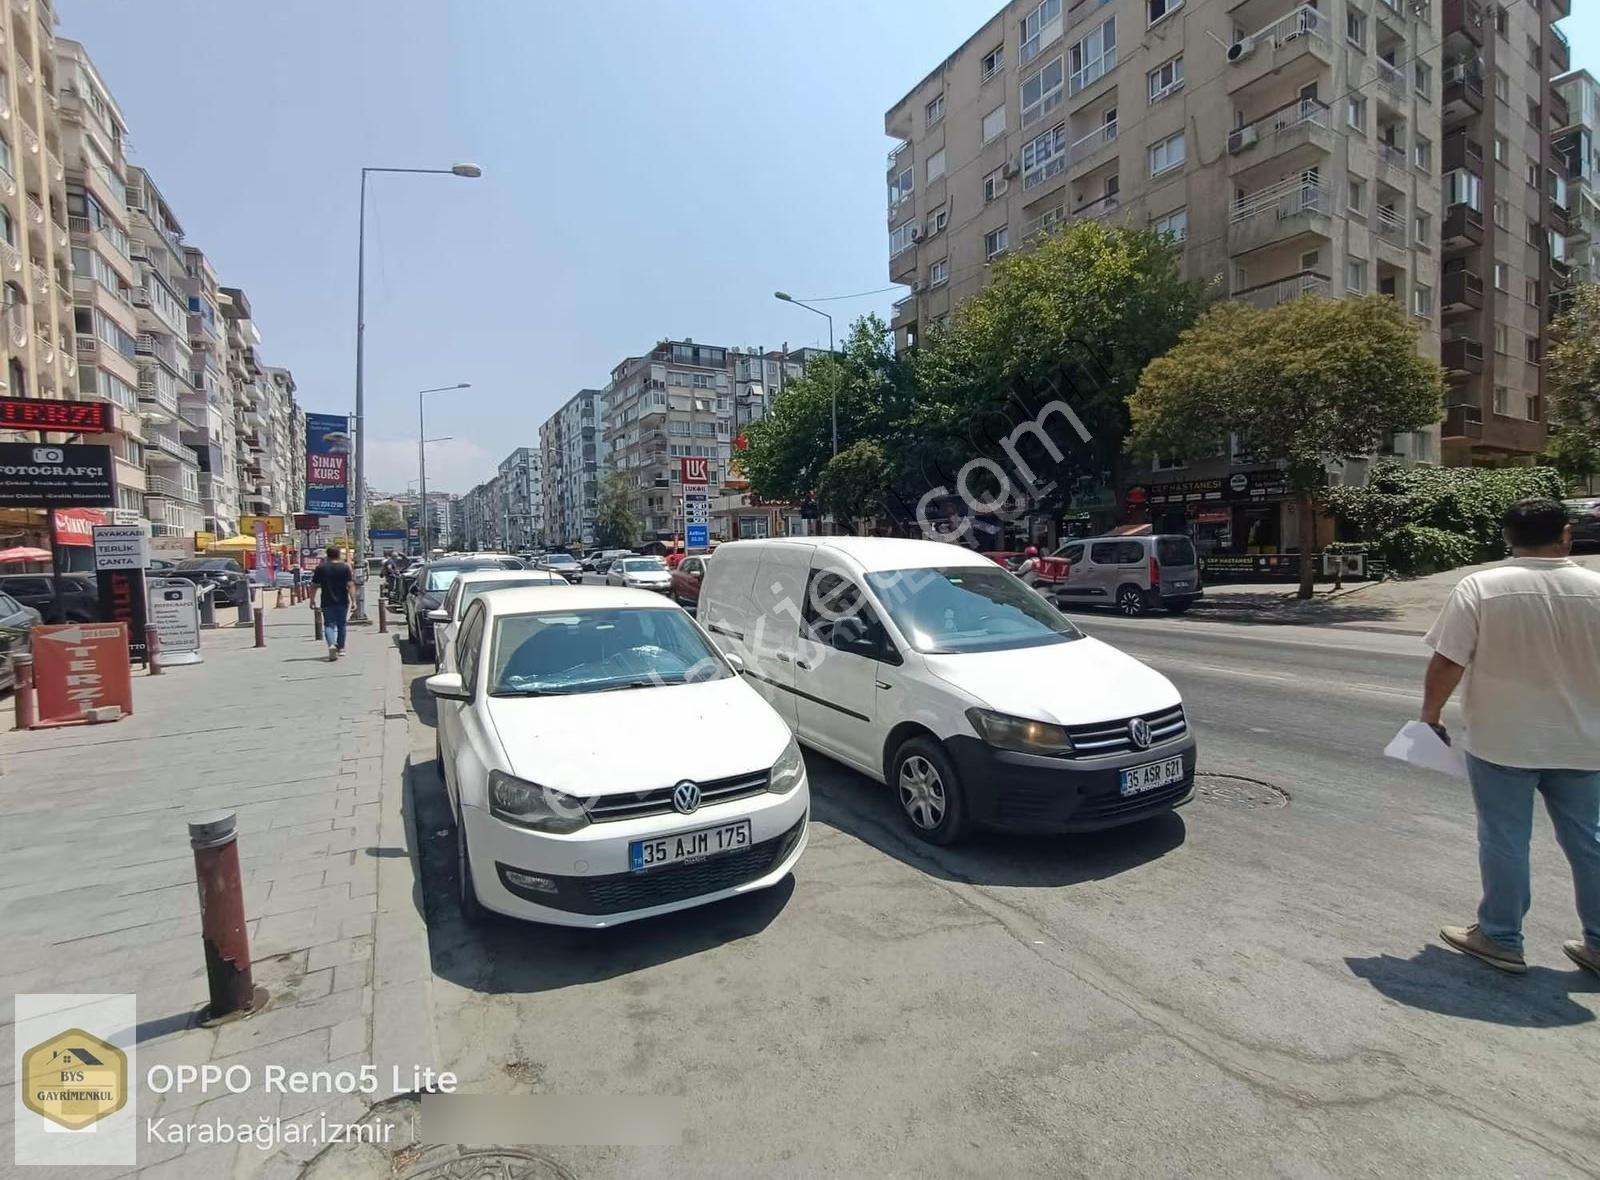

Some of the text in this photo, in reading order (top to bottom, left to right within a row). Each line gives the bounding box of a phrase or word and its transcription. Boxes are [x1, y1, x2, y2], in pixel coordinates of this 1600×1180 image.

[312, 455, 342, 468] SINAV
[314, 469, 340, 479] KURS
[99, 558, 134, 566] ÇANTA
[1127, 760, 1180, 788] 35 ASR 621
[643, 842, 667, 864] 35
[674, 833, 708, 858] AJM
[716, 825, 746, 849] 175
